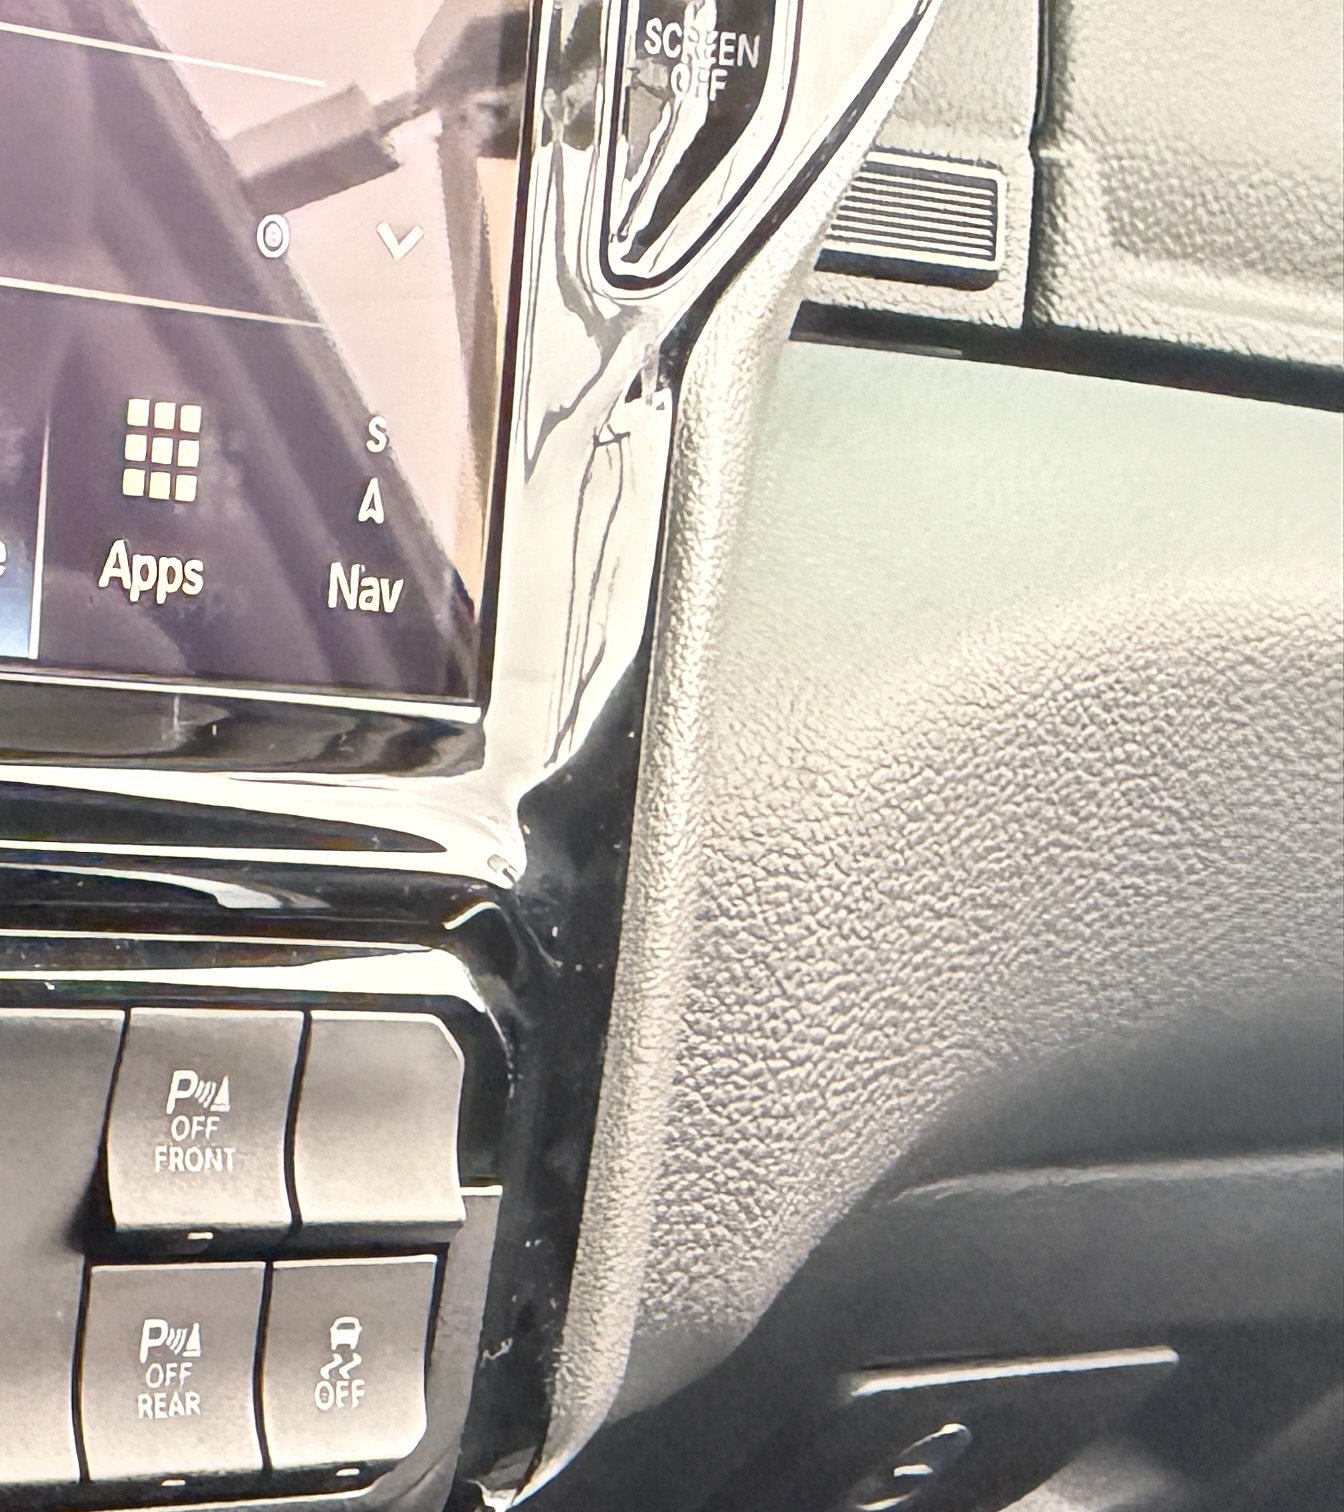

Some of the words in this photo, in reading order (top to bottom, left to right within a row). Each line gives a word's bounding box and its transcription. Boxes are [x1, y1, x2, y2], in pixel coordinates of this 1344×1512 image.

[365, 415, 389, 453] S
[98, 540, 205, 603] Apps
[326, 560, 405, 614] Nav
[170, 1115, 220, 1142] OFF
[153, 1144, 237, 1173] FRONT
[145, 1362, 193, 1390] OFF
[137, 1391, 201, 1420] REAR
[314, 1378, 366, 1411] OFF
